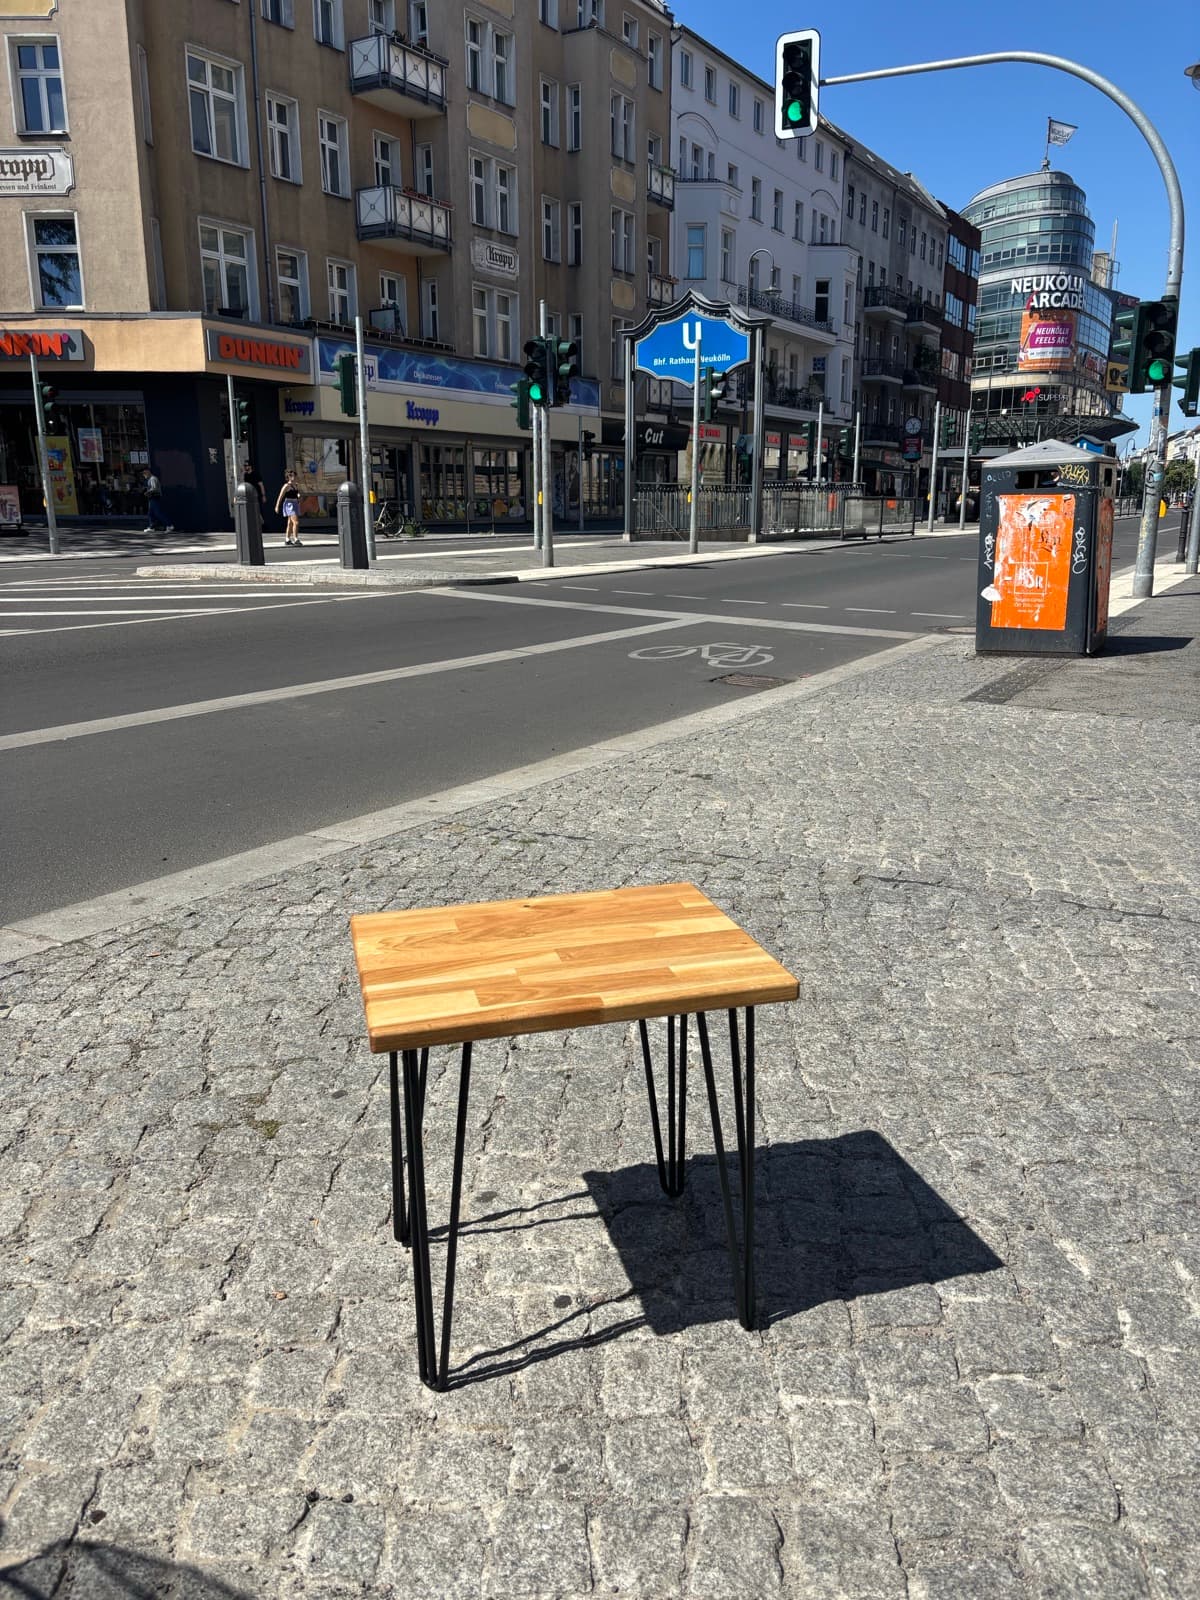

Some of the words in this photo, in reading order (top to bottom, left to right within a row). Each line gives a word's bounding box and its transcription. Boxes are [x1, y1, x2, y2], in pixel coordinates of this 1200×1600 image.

[682, 321, 702, 350] U
[1034, 336, 1056, 344] FEELS
[653, 357, 668, 366] Bhf.
[406, 400, 439, 426] Kropp
